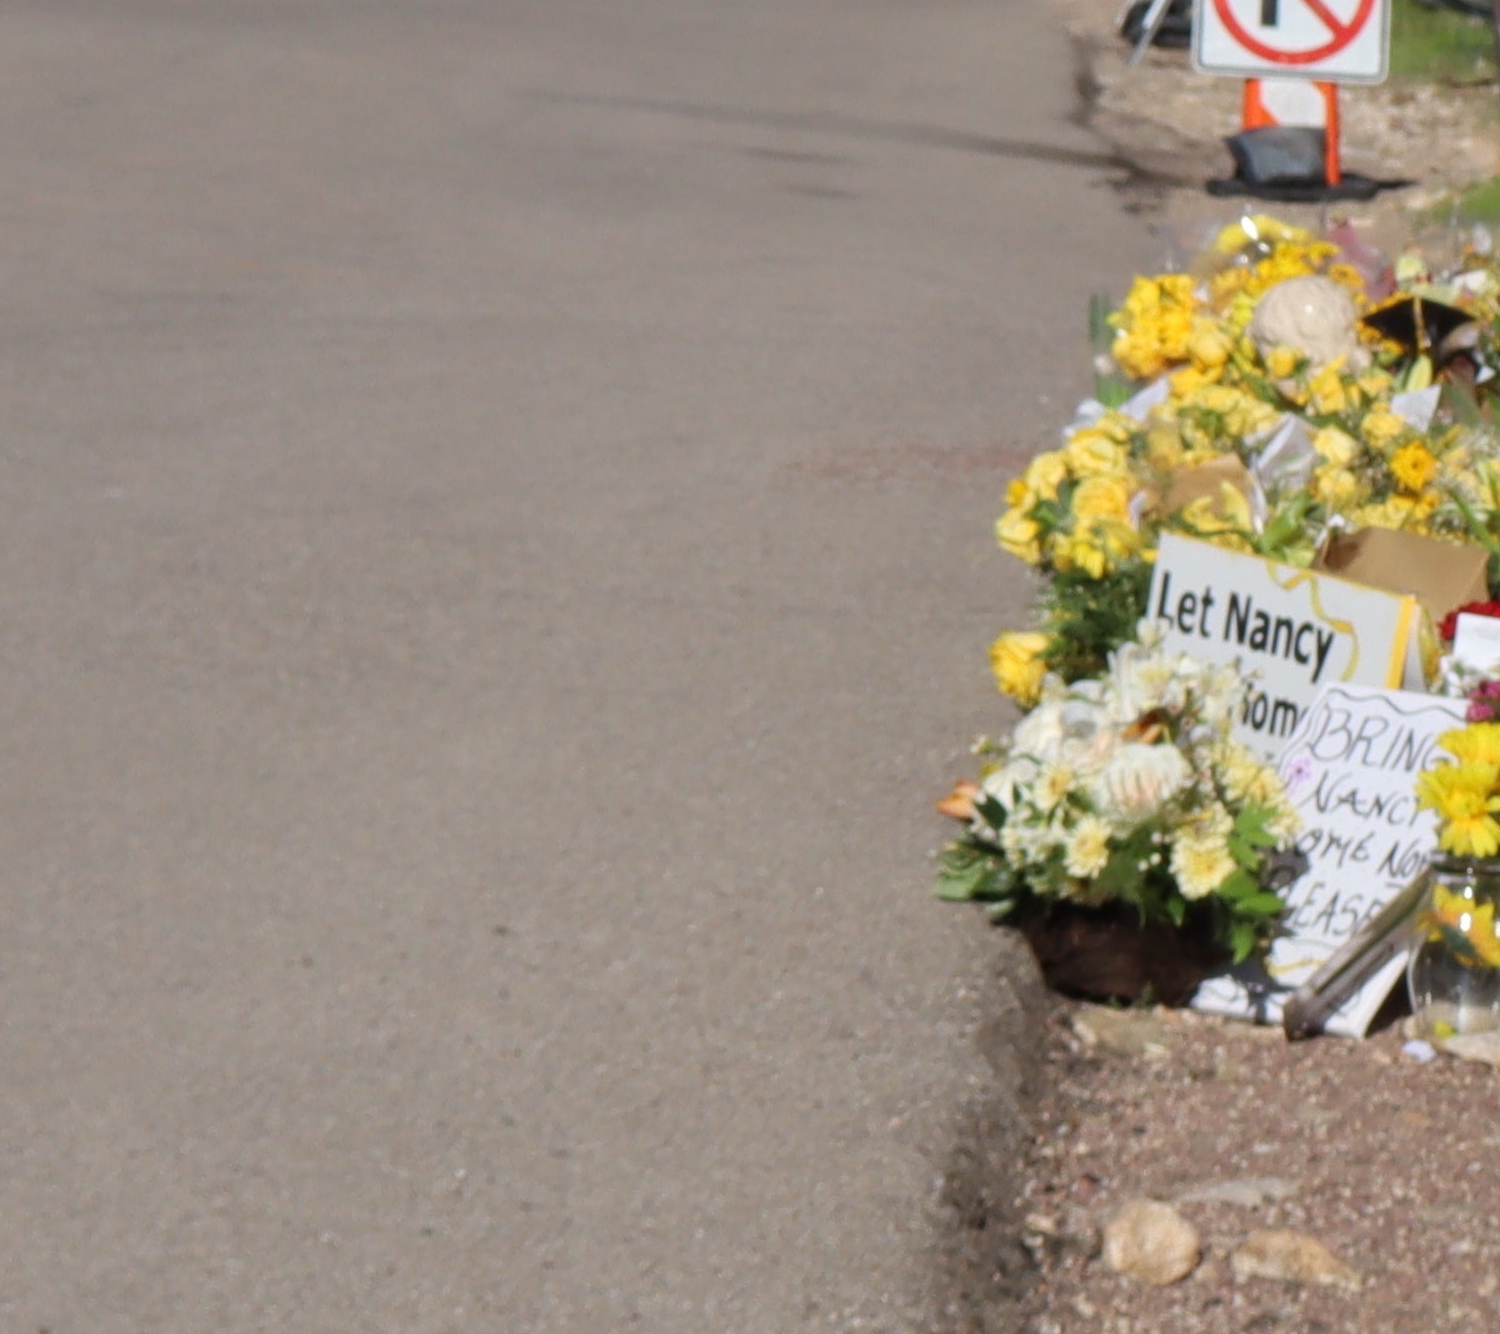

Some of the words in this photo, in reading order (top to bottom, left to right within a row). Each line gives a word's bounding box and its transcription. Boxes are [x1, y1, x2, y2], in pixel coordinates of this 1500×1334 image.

[1157, 570, 1214, 639] Let
[1223, 590, 1336, 685] Nancy
[1296, 828, 1377, 870] OME
